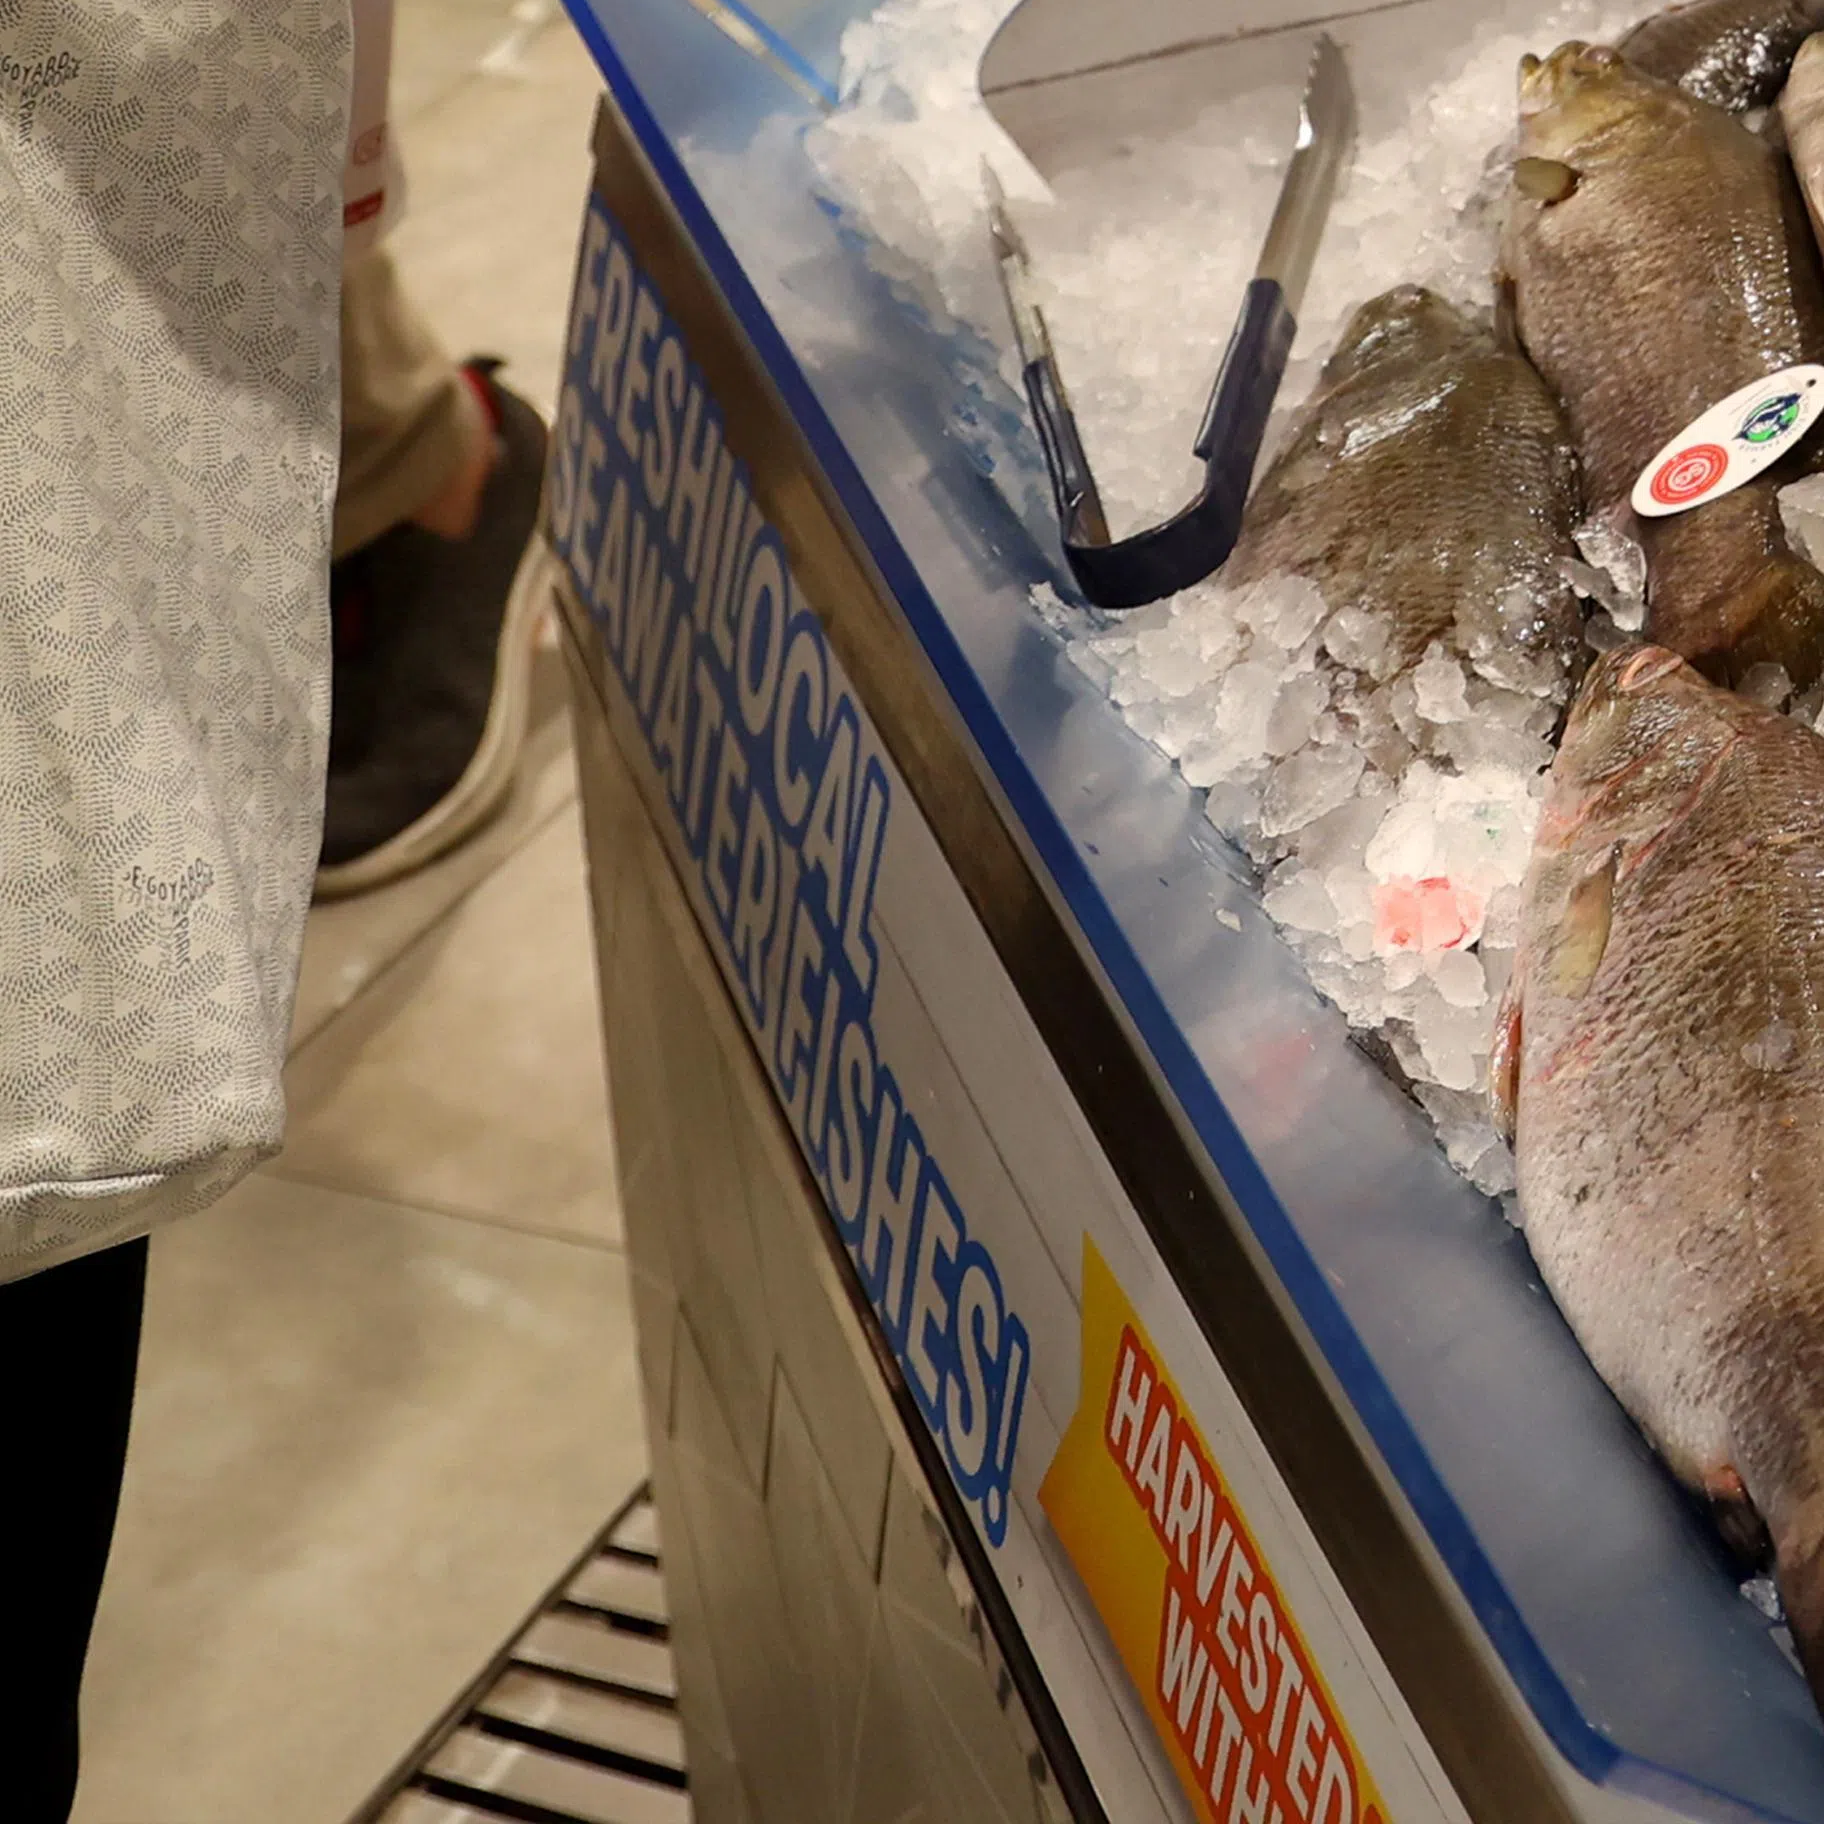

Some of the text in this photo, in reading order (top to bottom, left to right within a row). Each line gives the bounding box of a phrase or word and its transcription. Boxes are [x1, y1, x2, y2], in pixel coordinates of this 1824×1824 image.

[560, 198, 892, 998] FRESH LOCAL
[548, 376, 1030, 1548] SEAWATER FISHES!
[1108, 1336, 1356, 1824] HARVESTED
[1161, 1584, 1284, 1824] WITH
